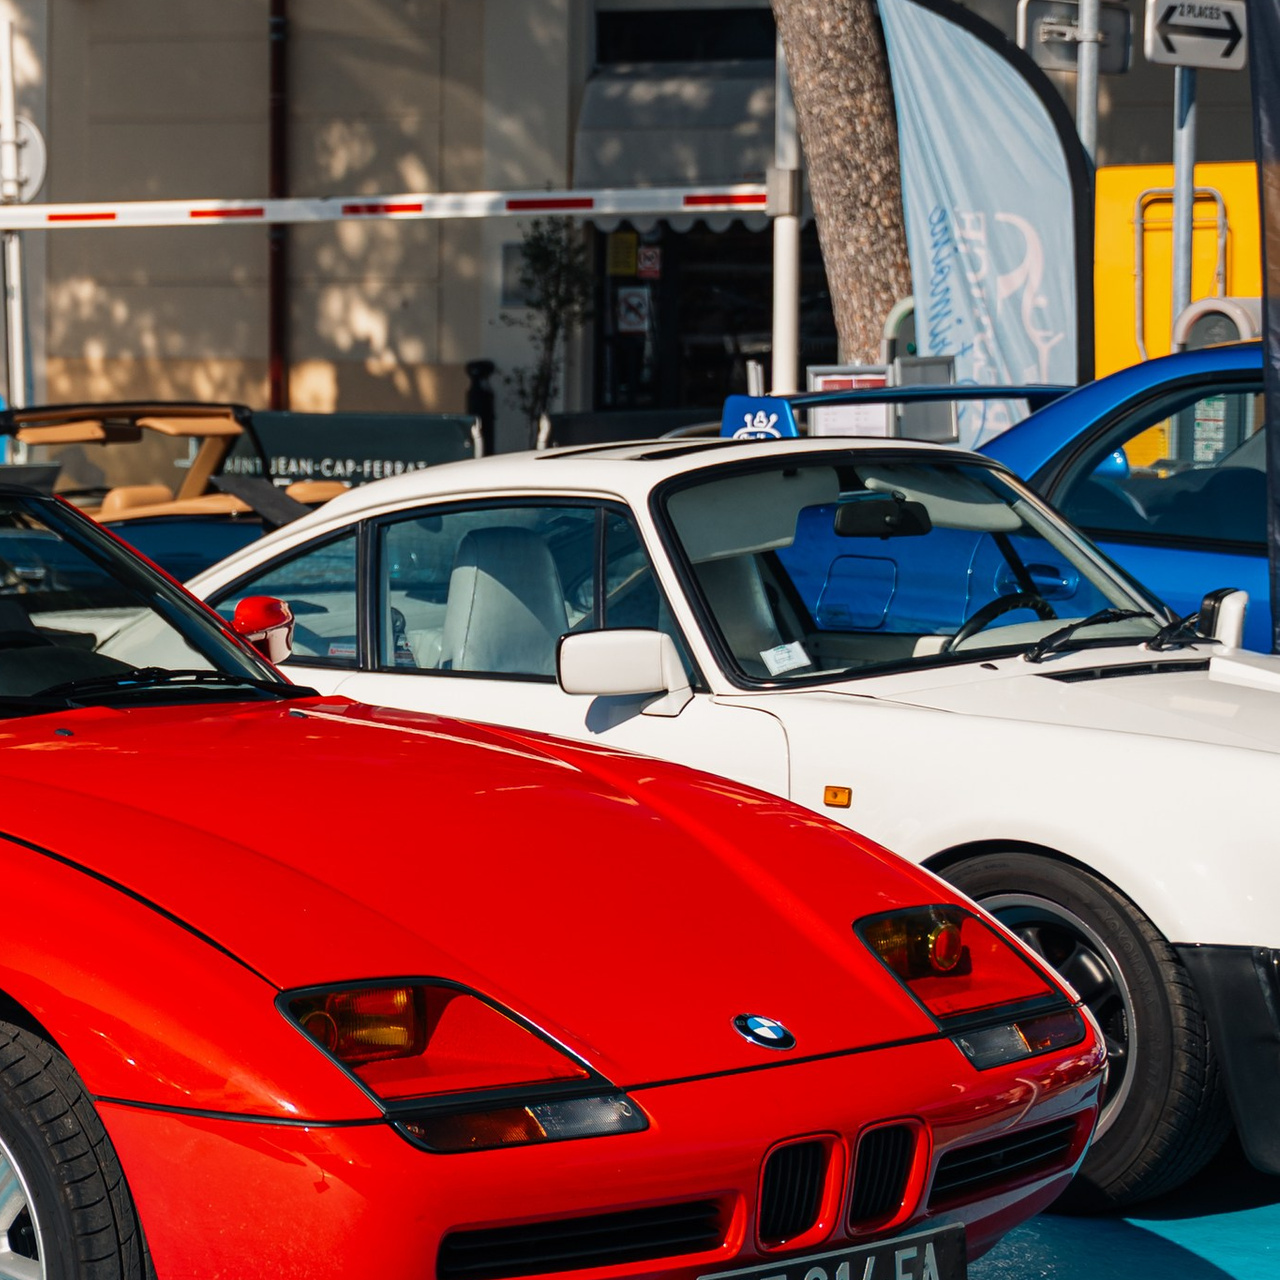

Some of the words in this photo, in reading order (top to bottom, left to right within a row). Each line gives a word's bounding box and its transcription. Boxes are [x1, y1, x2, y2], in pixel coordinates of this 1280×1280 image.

[1178, 3, 1185, 17] 2
[1187, 5, 1222, 20] PLACES
[223, 456, 263, 475] AINT
